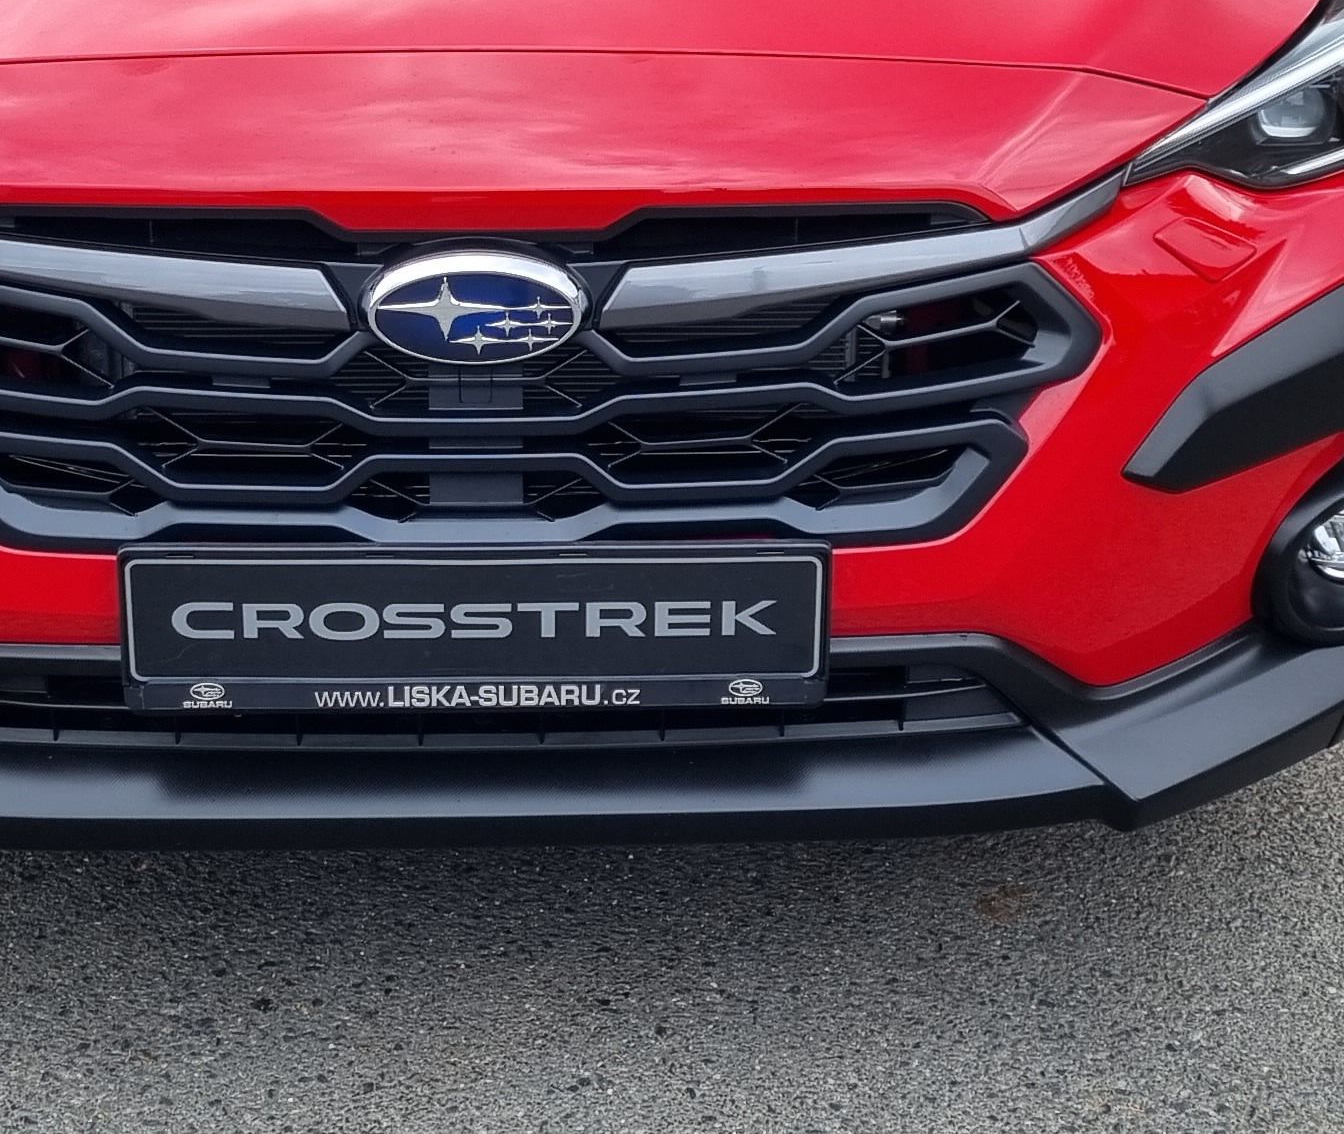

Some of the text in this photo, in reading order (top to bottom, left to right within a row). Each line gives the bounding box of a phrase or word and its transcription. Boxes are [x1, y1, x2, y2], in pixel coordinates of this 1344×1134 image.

[171, 601, 777, 641] CROSSTREK
[183, 700, 233, 709] SUBARU
[314, 685, 641, 710] www.LISKA-SUBARU.cz
[720, 696, 770, 705] SUBARU
